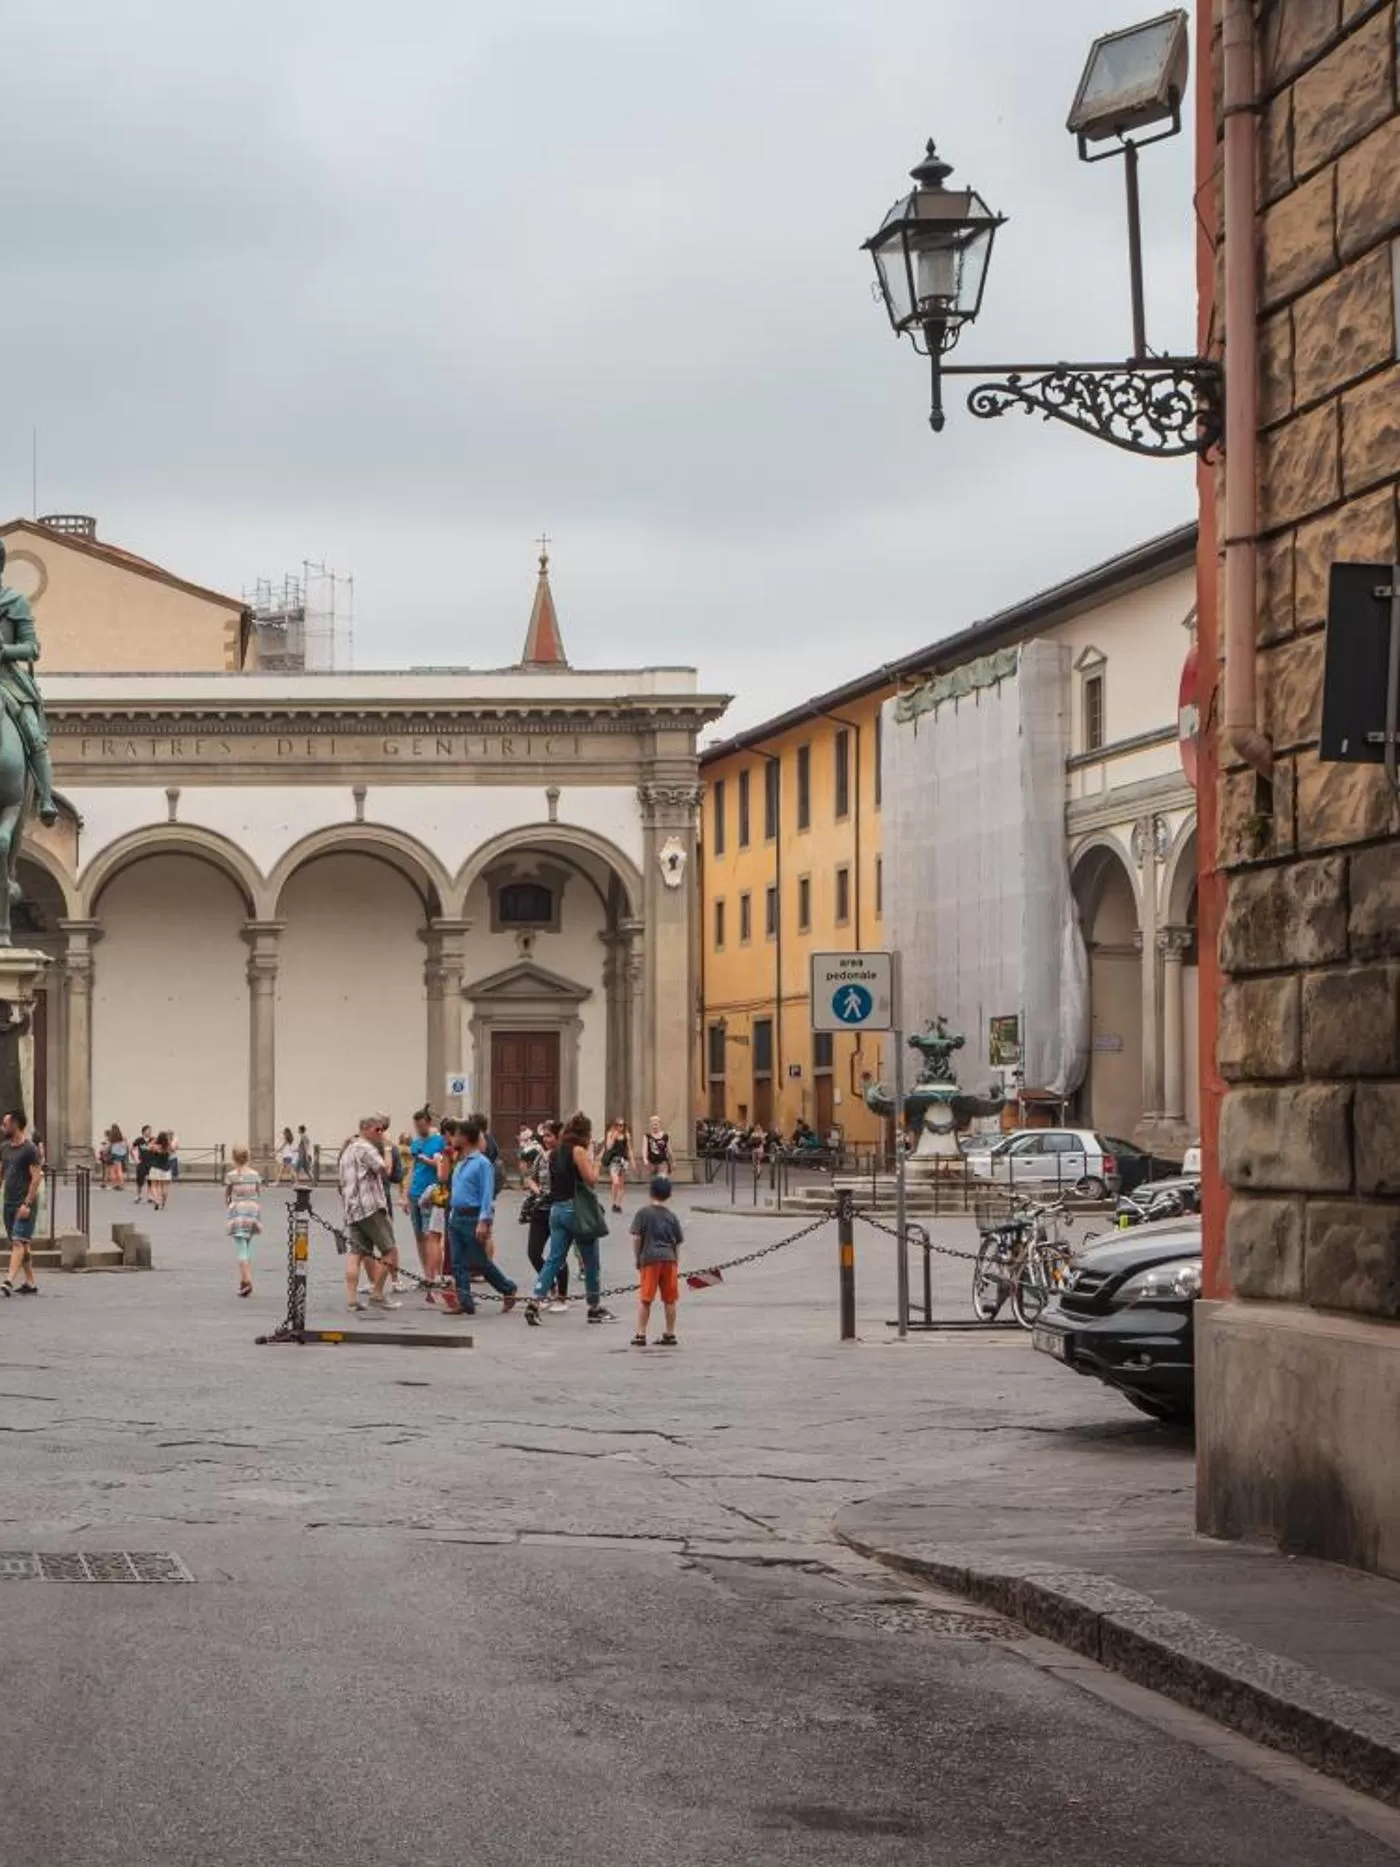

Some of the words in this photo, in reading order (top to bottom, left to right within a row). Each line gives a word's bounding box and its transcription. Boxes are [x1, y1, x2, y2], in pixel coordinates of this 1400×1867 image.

[80, 738, 233, 758] FRATRES
[277, 738, 337, 757] DEI
[839, 959, 864, 967] area
[826, 970, 877, 981] pedonale
